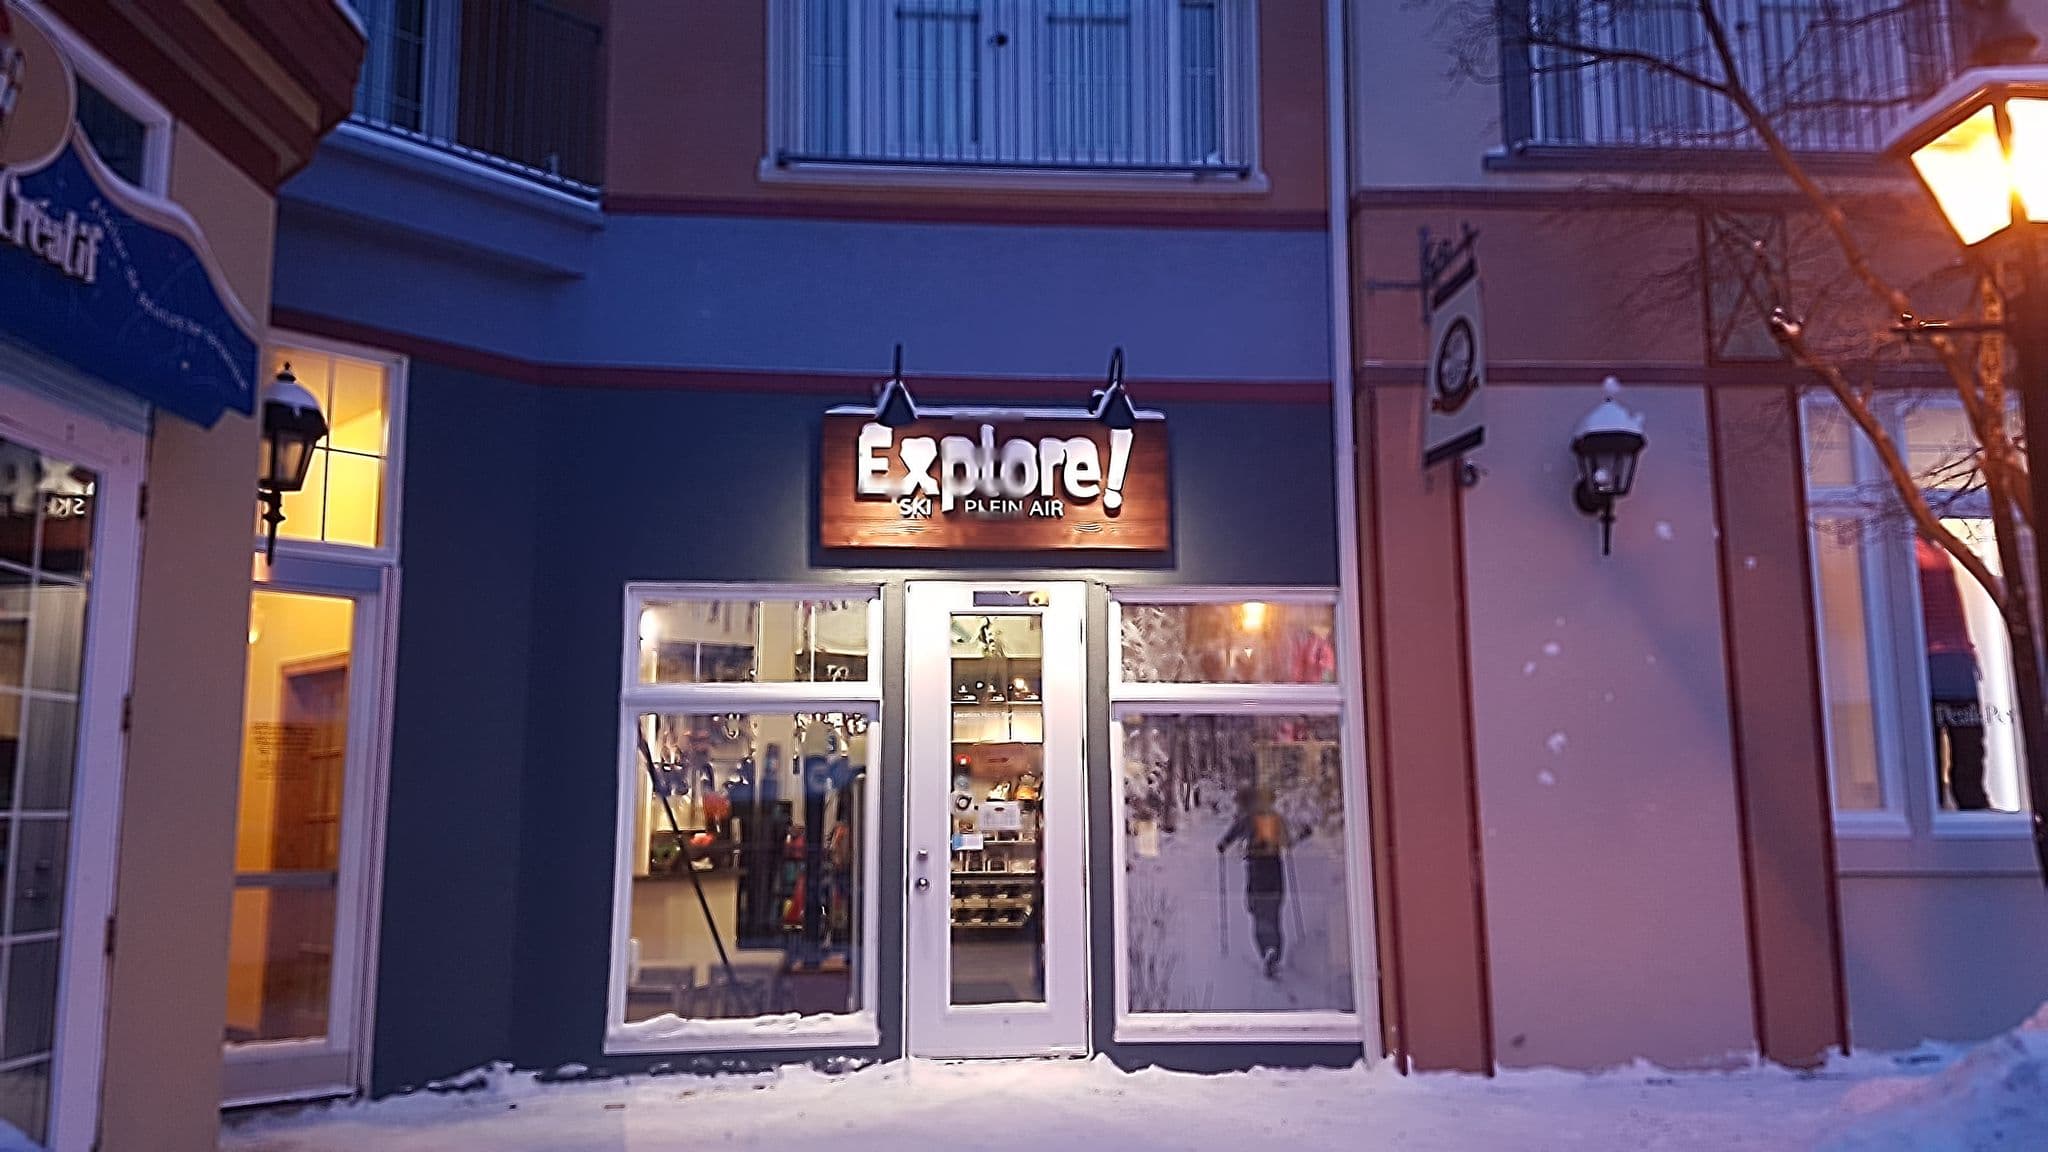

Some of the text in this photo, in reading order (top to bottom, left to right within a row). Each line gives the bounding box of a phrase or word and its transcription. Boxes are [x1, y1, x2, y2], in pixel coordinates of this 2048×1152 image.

[858, 422, 1134, 509] Explore!
[900, 498, 931, 516] SKI
[1029, 499, 1064, 516] AIR
